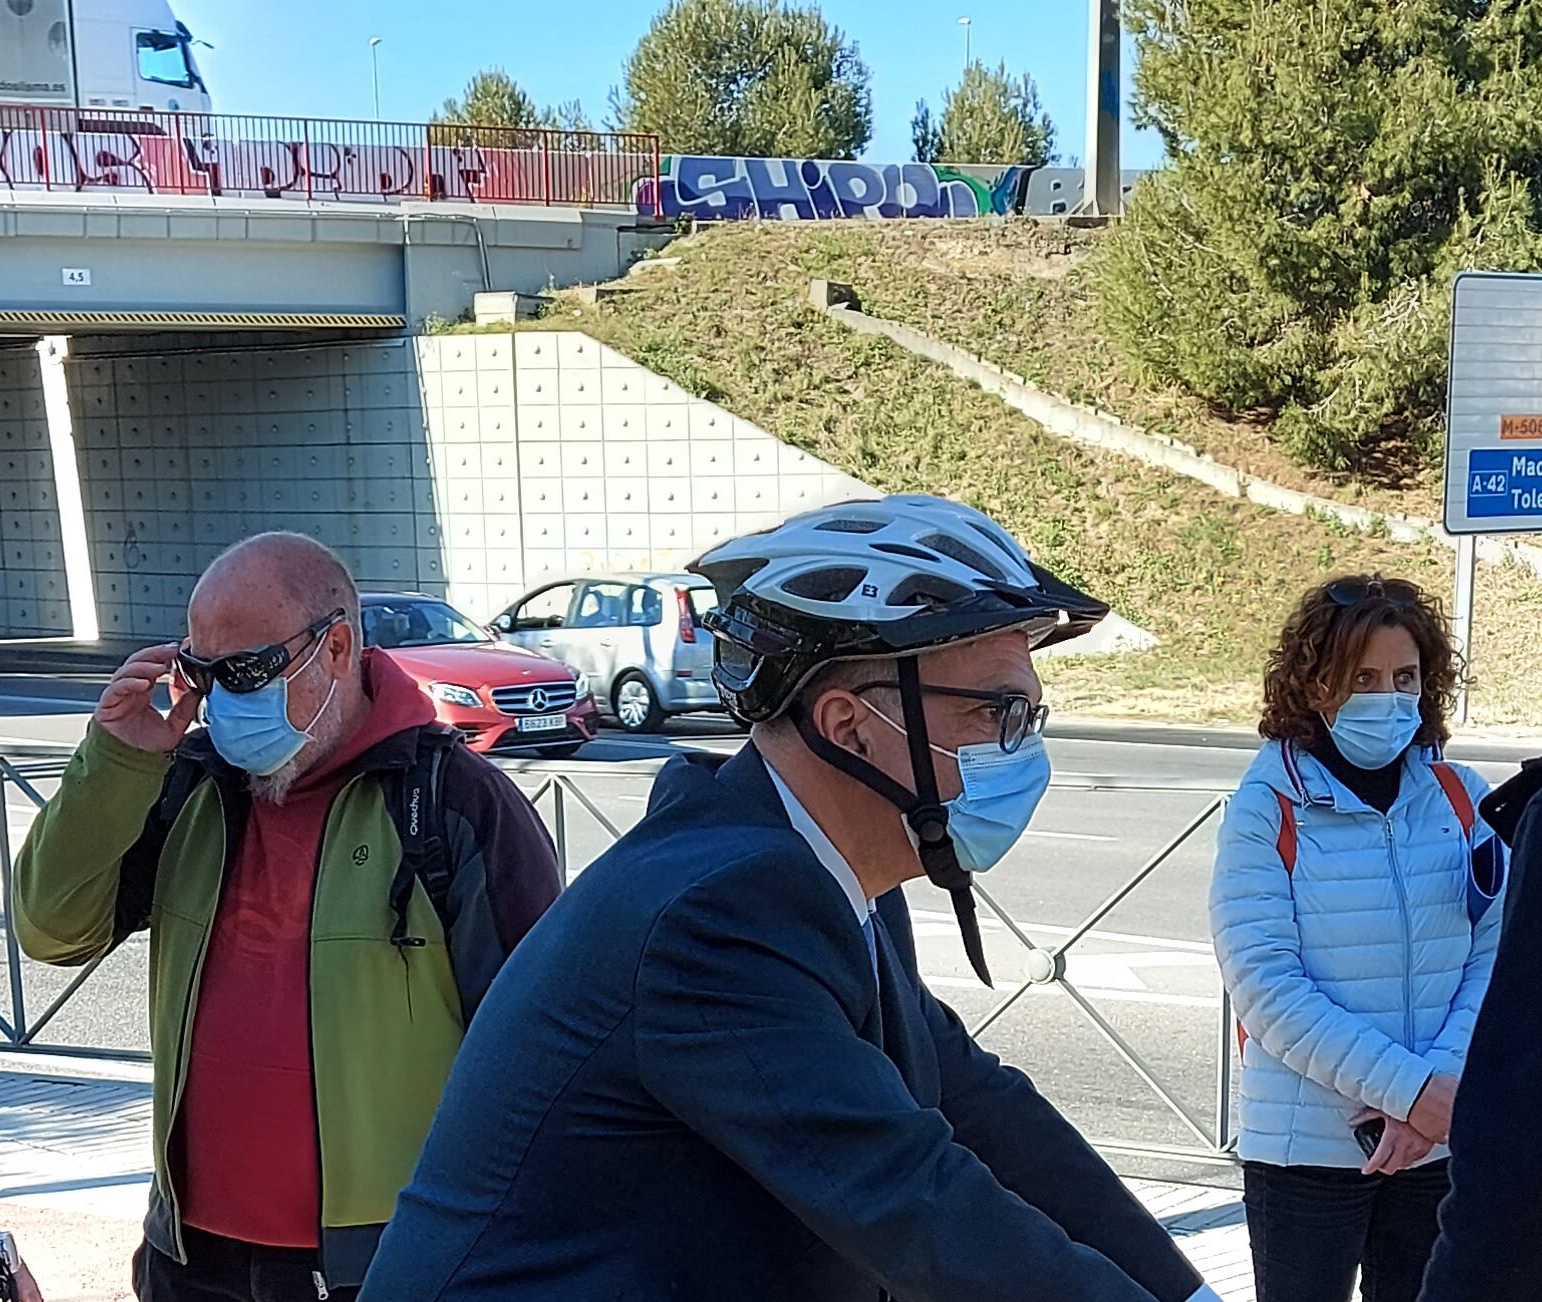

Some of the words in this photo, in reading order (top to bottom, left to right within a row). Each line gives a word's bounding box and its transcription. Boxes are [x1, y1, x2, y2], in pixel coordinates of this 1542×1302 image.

[1471, 475, 1505, 492] A-42
[861, 584, 879, 598] E3
[409, 787, 420, 836] Quechua
